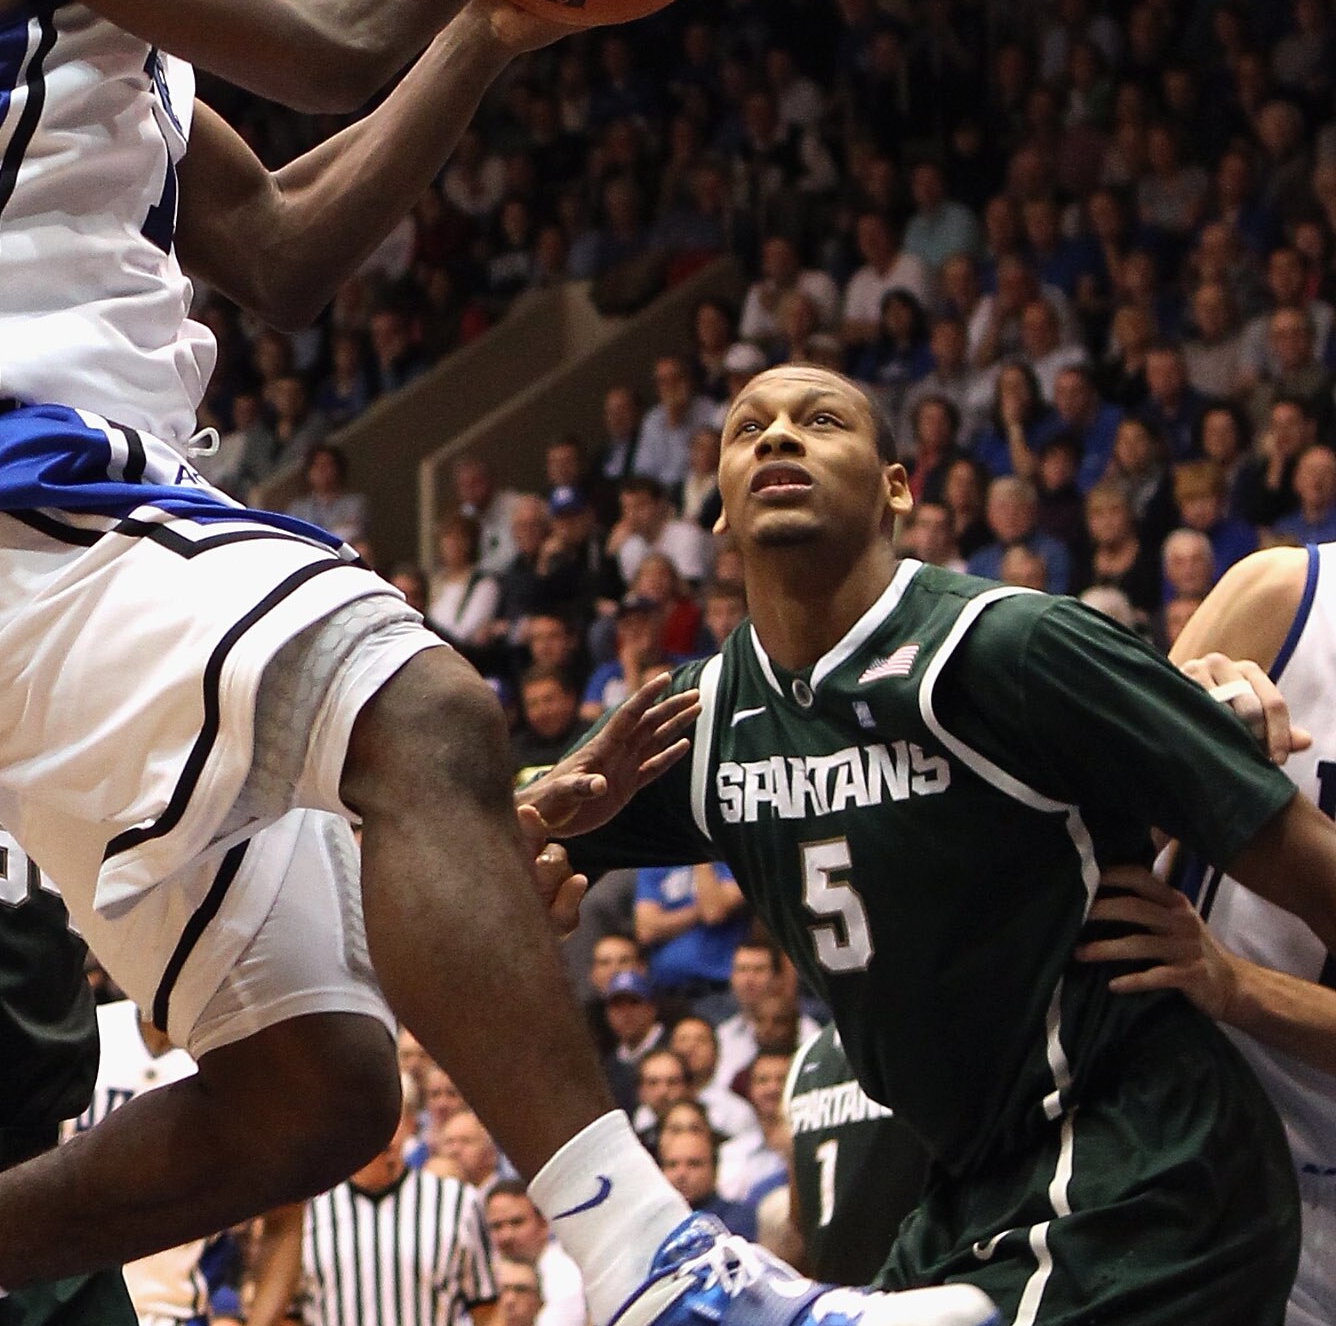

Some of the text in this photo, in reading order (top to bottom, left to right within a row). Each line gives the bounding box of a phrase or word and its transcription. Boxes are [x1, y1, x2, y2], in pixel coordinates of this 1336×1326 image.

[716, 739, 952, 824] SPARTANS
[798, 835, 876, 972] 5
[790, 1079, 894, 1137] SPARTAN
[815, 1138, 839, 1227] 1
